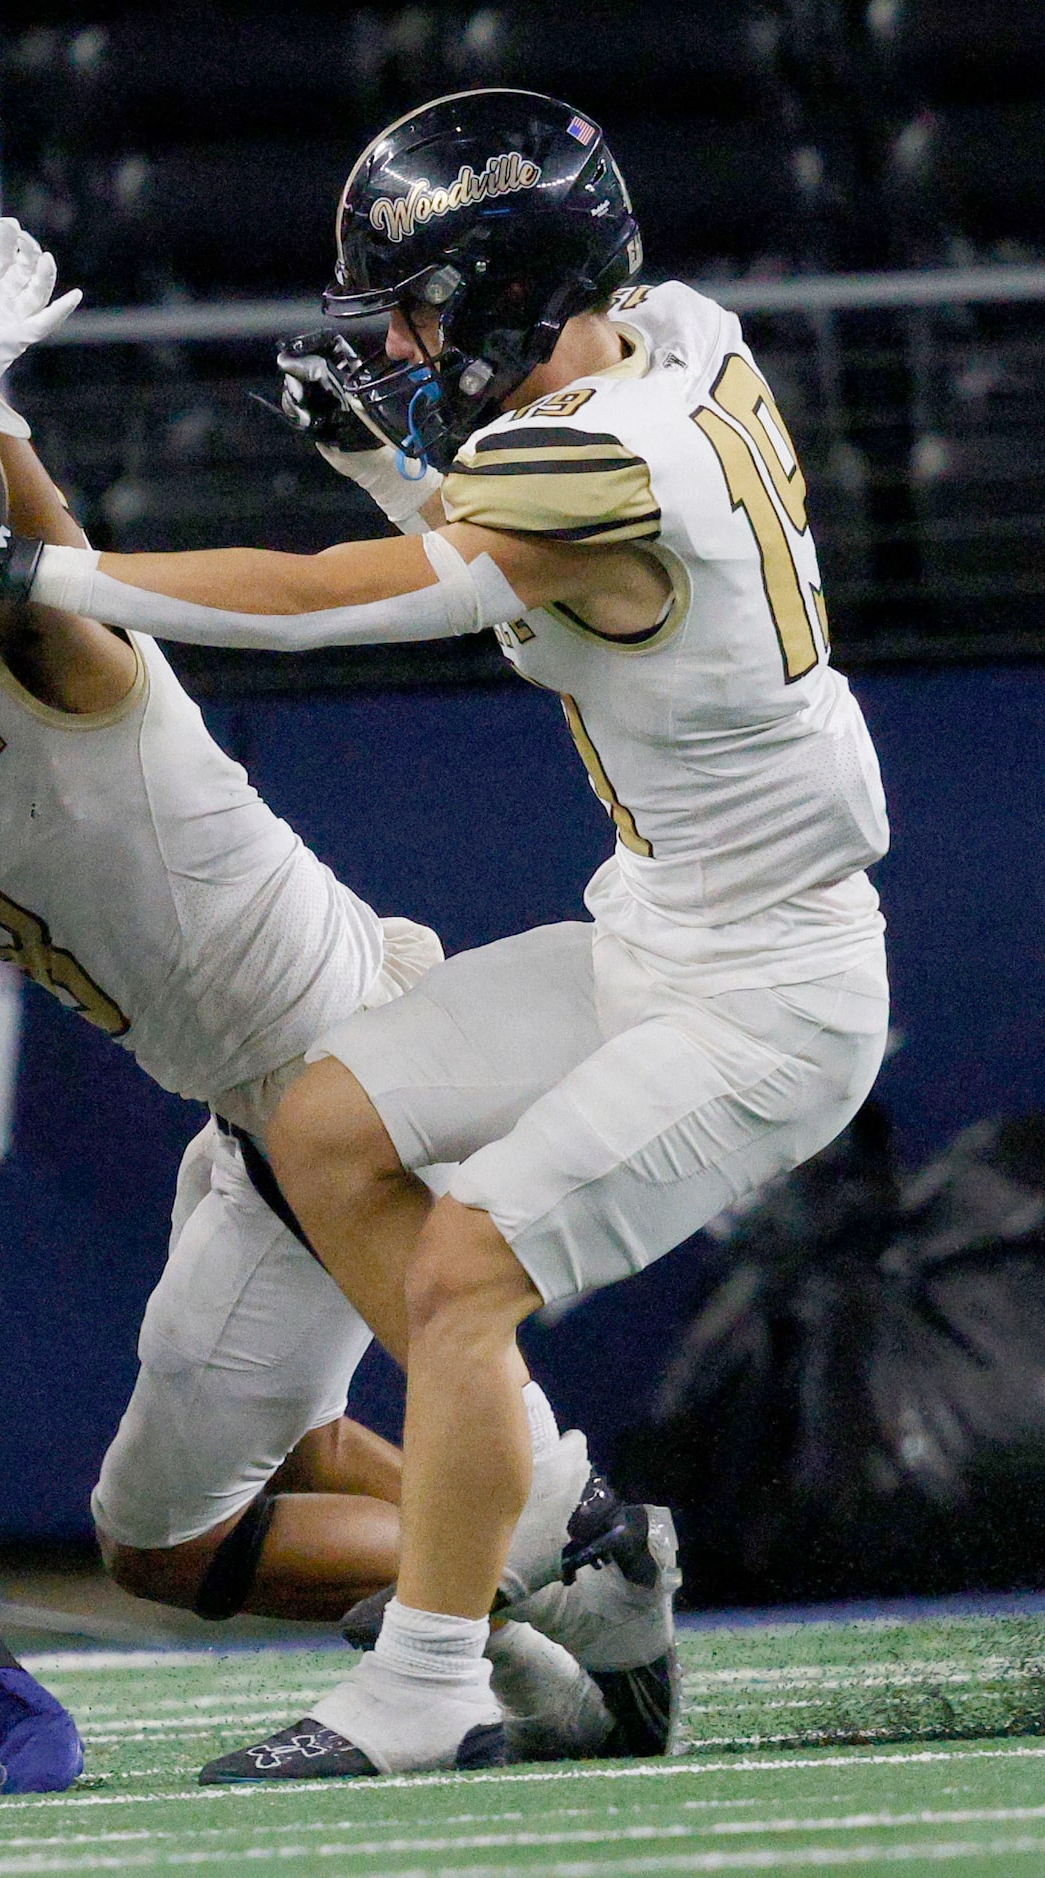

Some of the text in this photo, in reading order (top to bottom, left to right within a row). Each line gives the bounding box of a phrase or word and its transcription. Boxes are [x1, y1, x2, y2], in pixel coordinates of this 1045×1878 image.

[369, 151, 541, 243] Woodville
[509, 388, 597, 421] 19
[689, 353, 831, 685] 19
